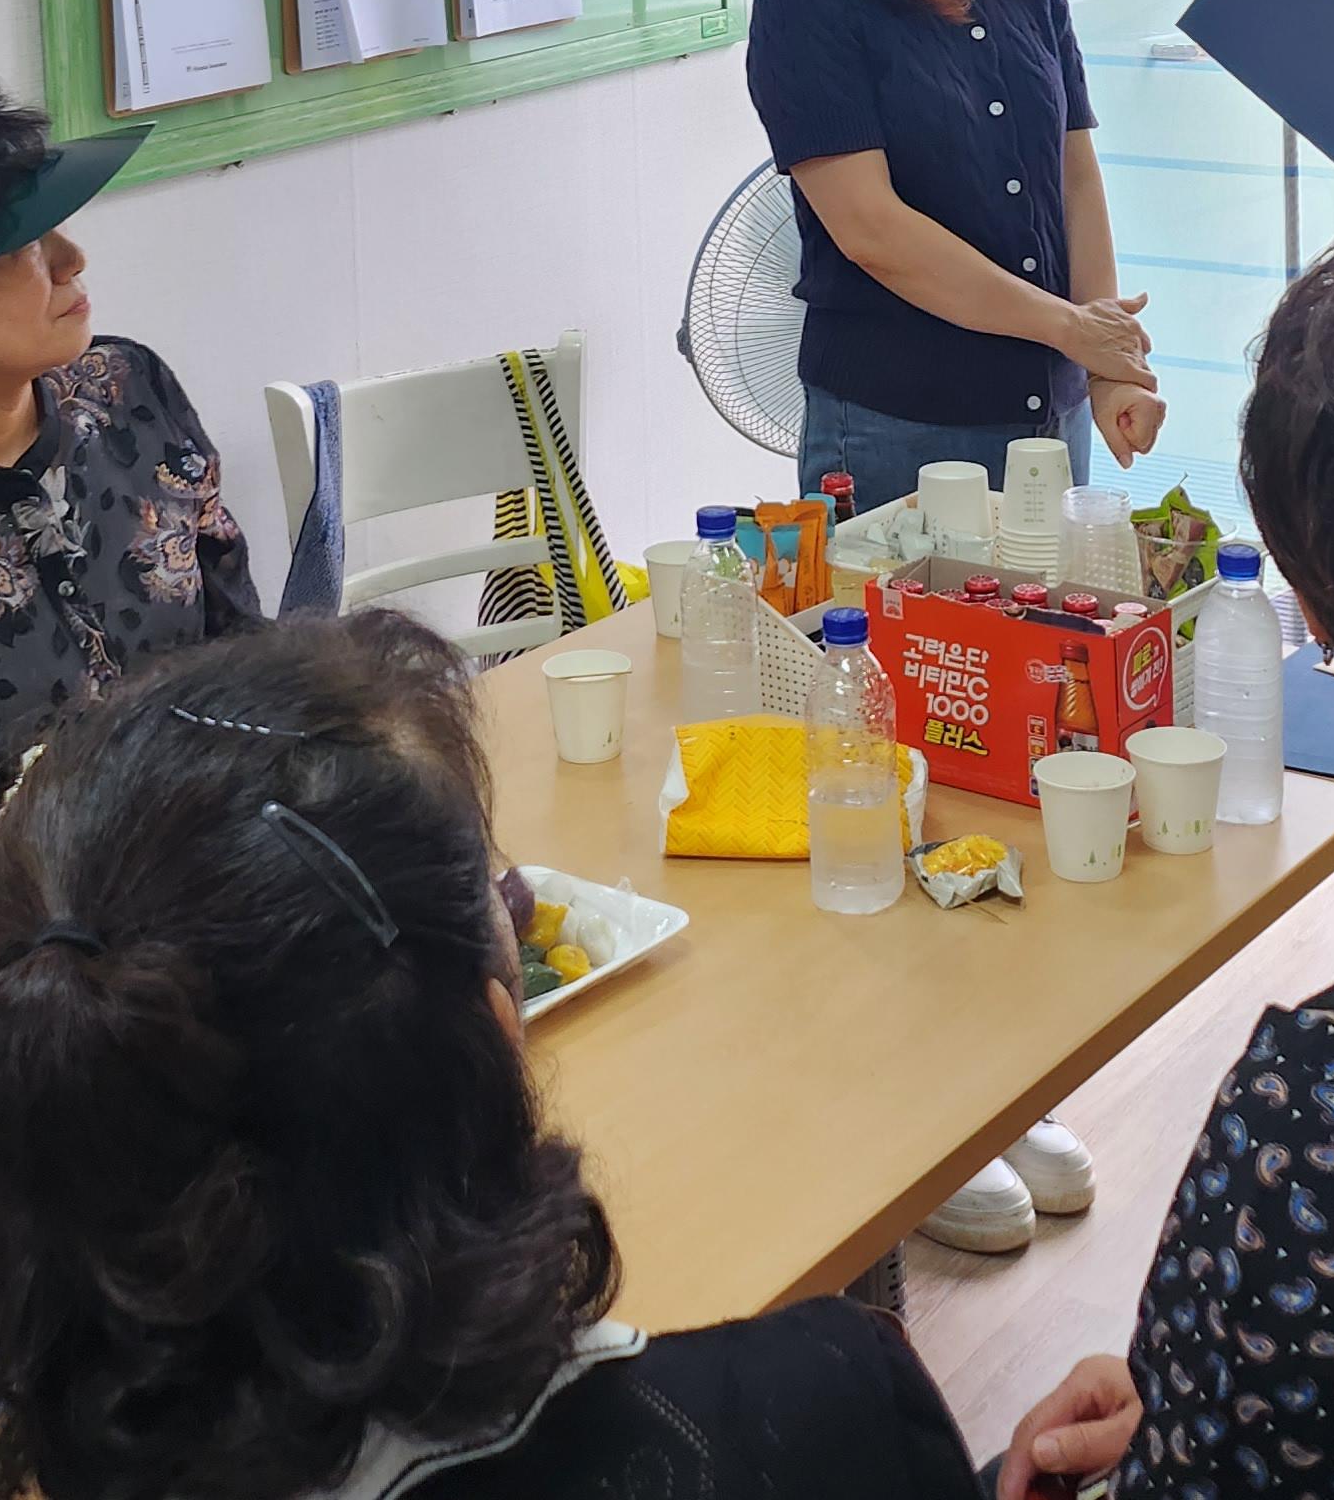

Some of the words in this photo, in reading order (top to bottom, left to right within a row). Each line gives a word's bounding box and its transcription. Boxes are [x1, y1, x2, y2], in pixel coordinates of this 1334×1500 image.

[903, 633, 990, 675] 고려은단
[904, 660, 990, 701] 비타민C
[926, 692, 989, 725] 1000
[924, 718, 989, 756] 플러스
